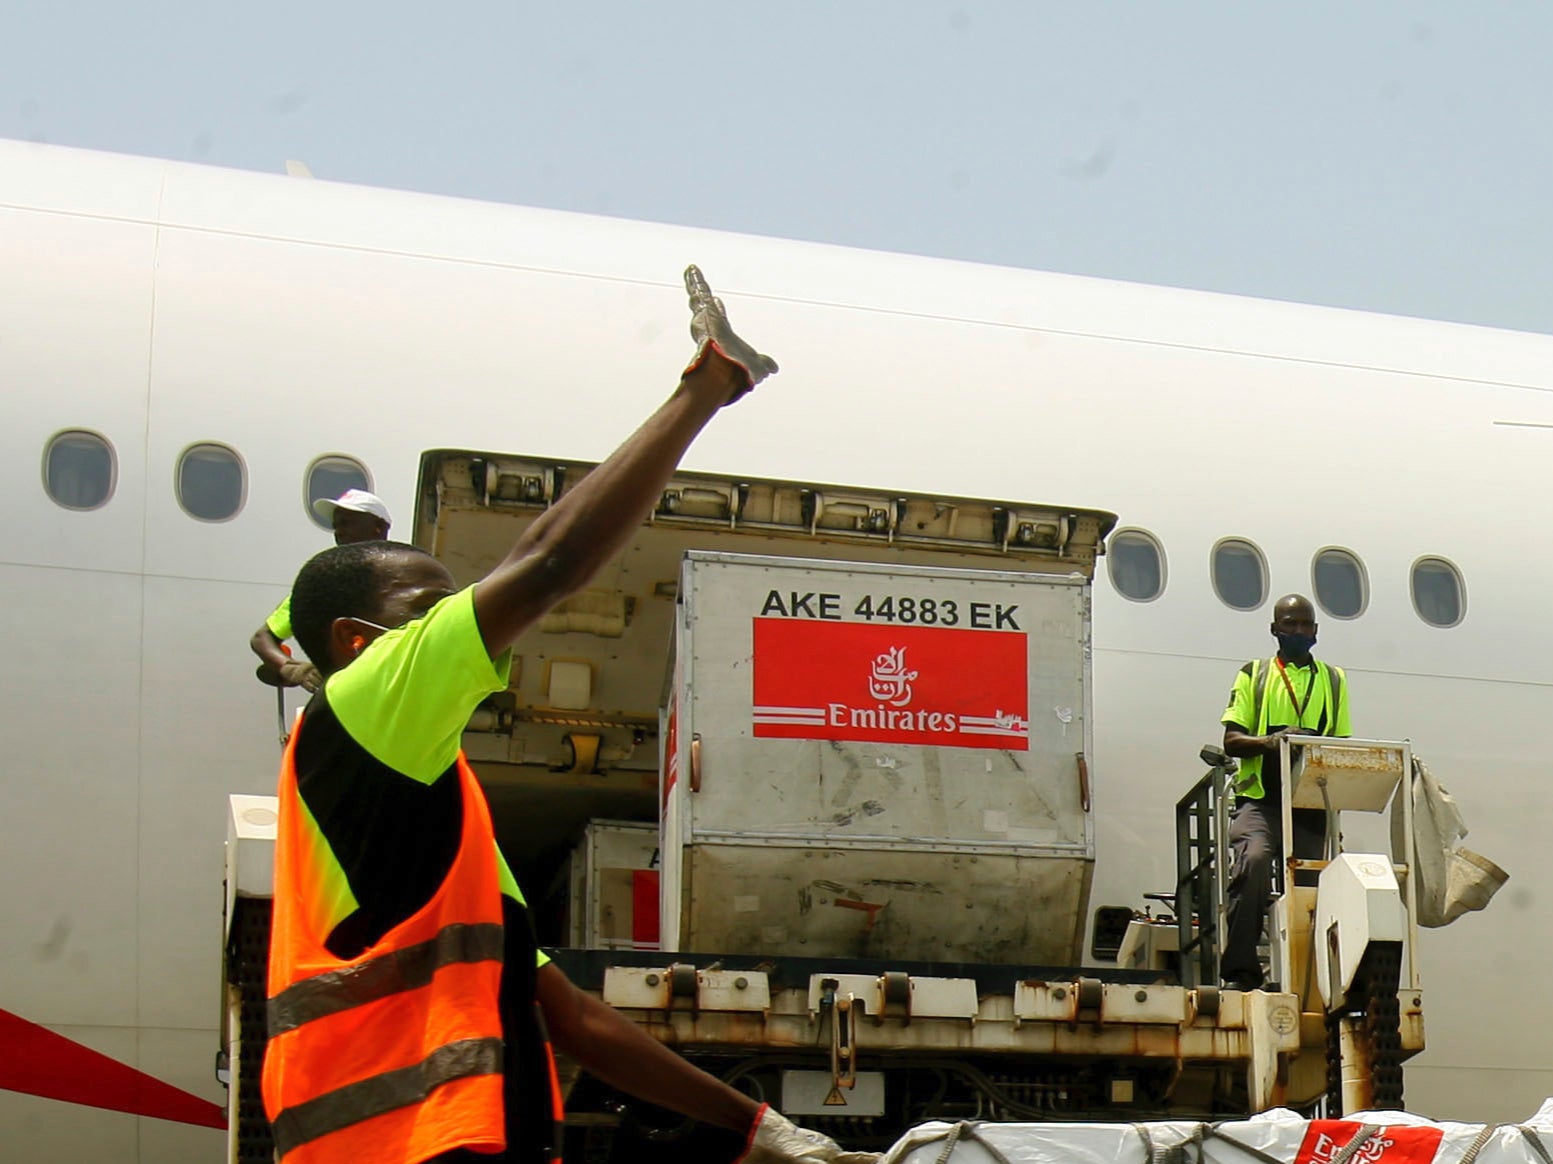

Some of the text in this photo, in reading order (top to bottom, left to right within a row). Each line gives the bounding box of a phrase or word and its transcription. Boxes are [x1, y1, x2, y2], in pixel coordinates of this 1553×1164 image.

[760, 589, 1022, 631] AKE 44883 EK
[828, 703, 957, 733] Emirates
